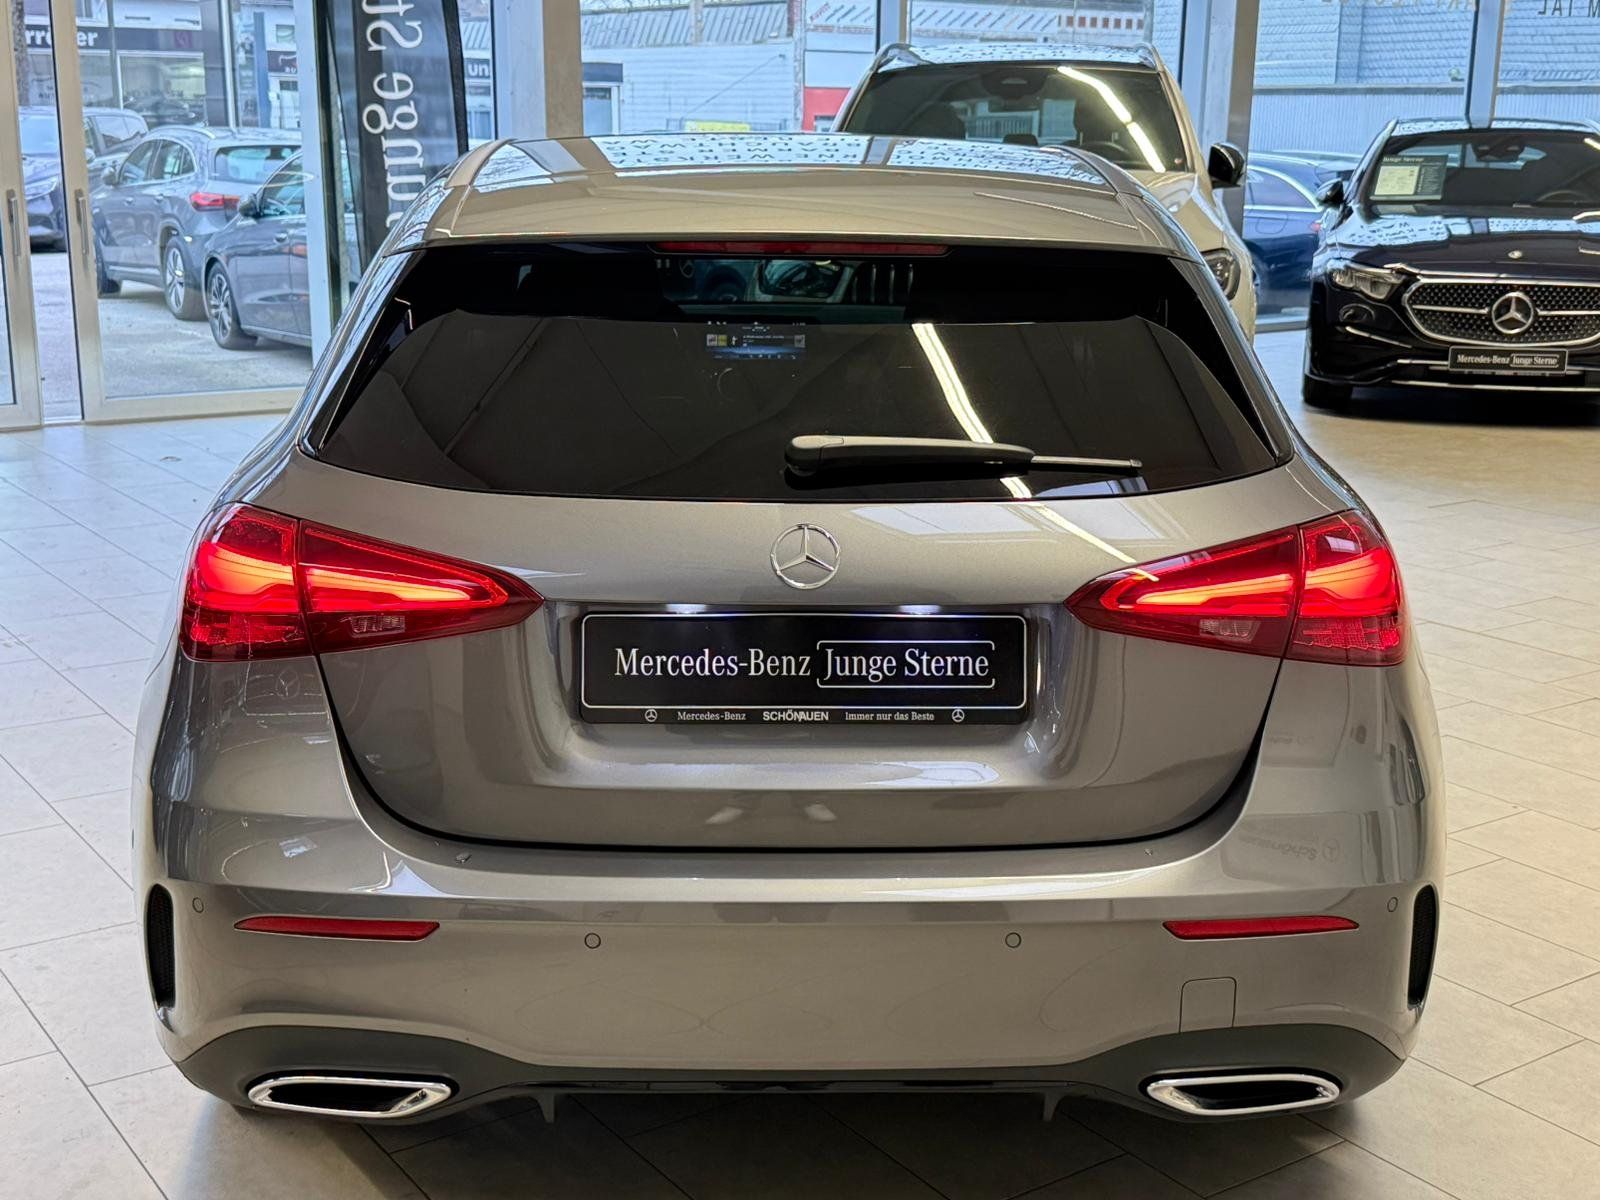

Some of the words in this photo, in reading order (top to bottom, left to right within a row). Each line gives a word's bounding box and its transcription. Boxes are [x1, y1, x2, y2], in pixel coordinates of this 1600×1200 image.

[1457, 354, 1510, 364] Mercedes-Benz
[1512, 355, 1532, 366] Junge
[1533, 355, 1558, 365] Sterne
[614, 648, 811, 677] Mercedes-Benz
[823, 648, 897, 683] Junge
[904, 648, 989, 677] Sterne
[677, 711, 746, 721] Mercedes-Benz
[845, 711, 875, 721] Immer
[876, 713, 891, 721] nur
[893, 711, 910, 721] das
[911, 711, 935, 721] Beste
